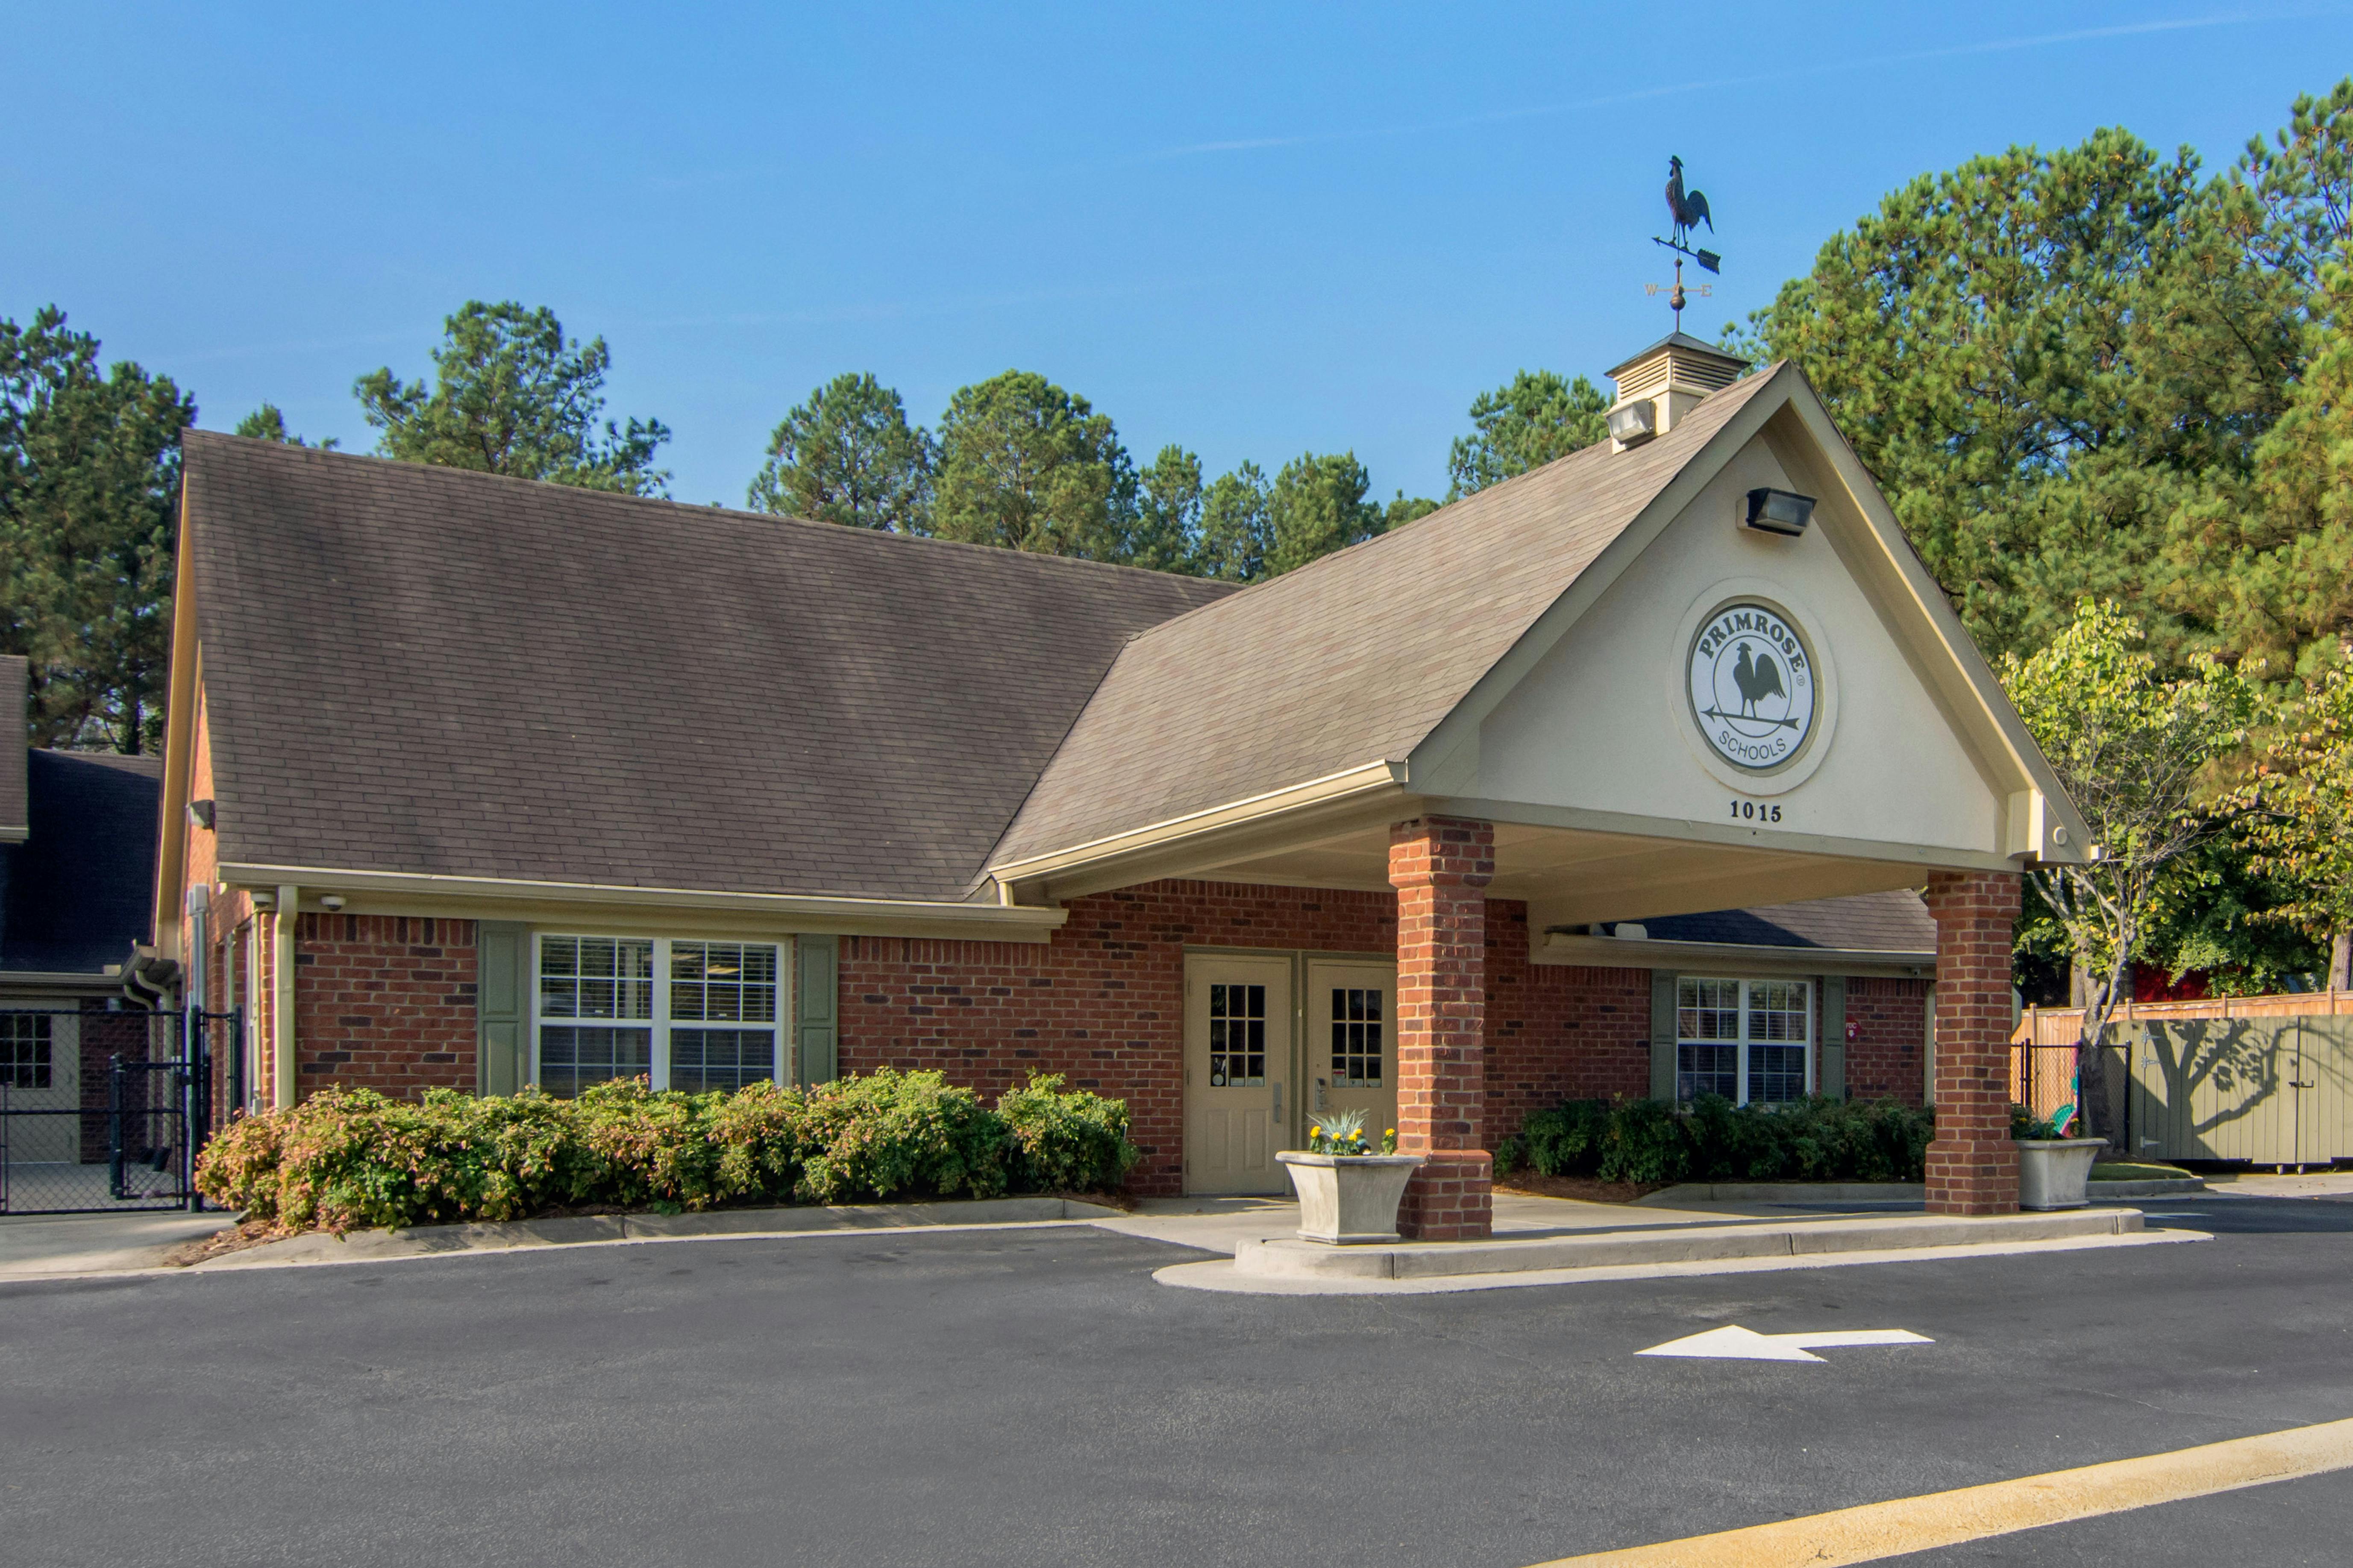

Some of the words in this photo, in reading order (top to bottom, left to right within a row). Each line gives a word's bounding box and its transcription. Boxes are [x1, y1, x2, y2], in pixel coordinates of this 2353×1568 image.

[1645, 284, 1658, 296] W
[1701, 284, 1712, 297] E
[1699, 613, 1805, 673] PRIMROSE
[1719, 731, 1786, 760] SCHOOLS
[1731, 801, 1781, 822] 1015
